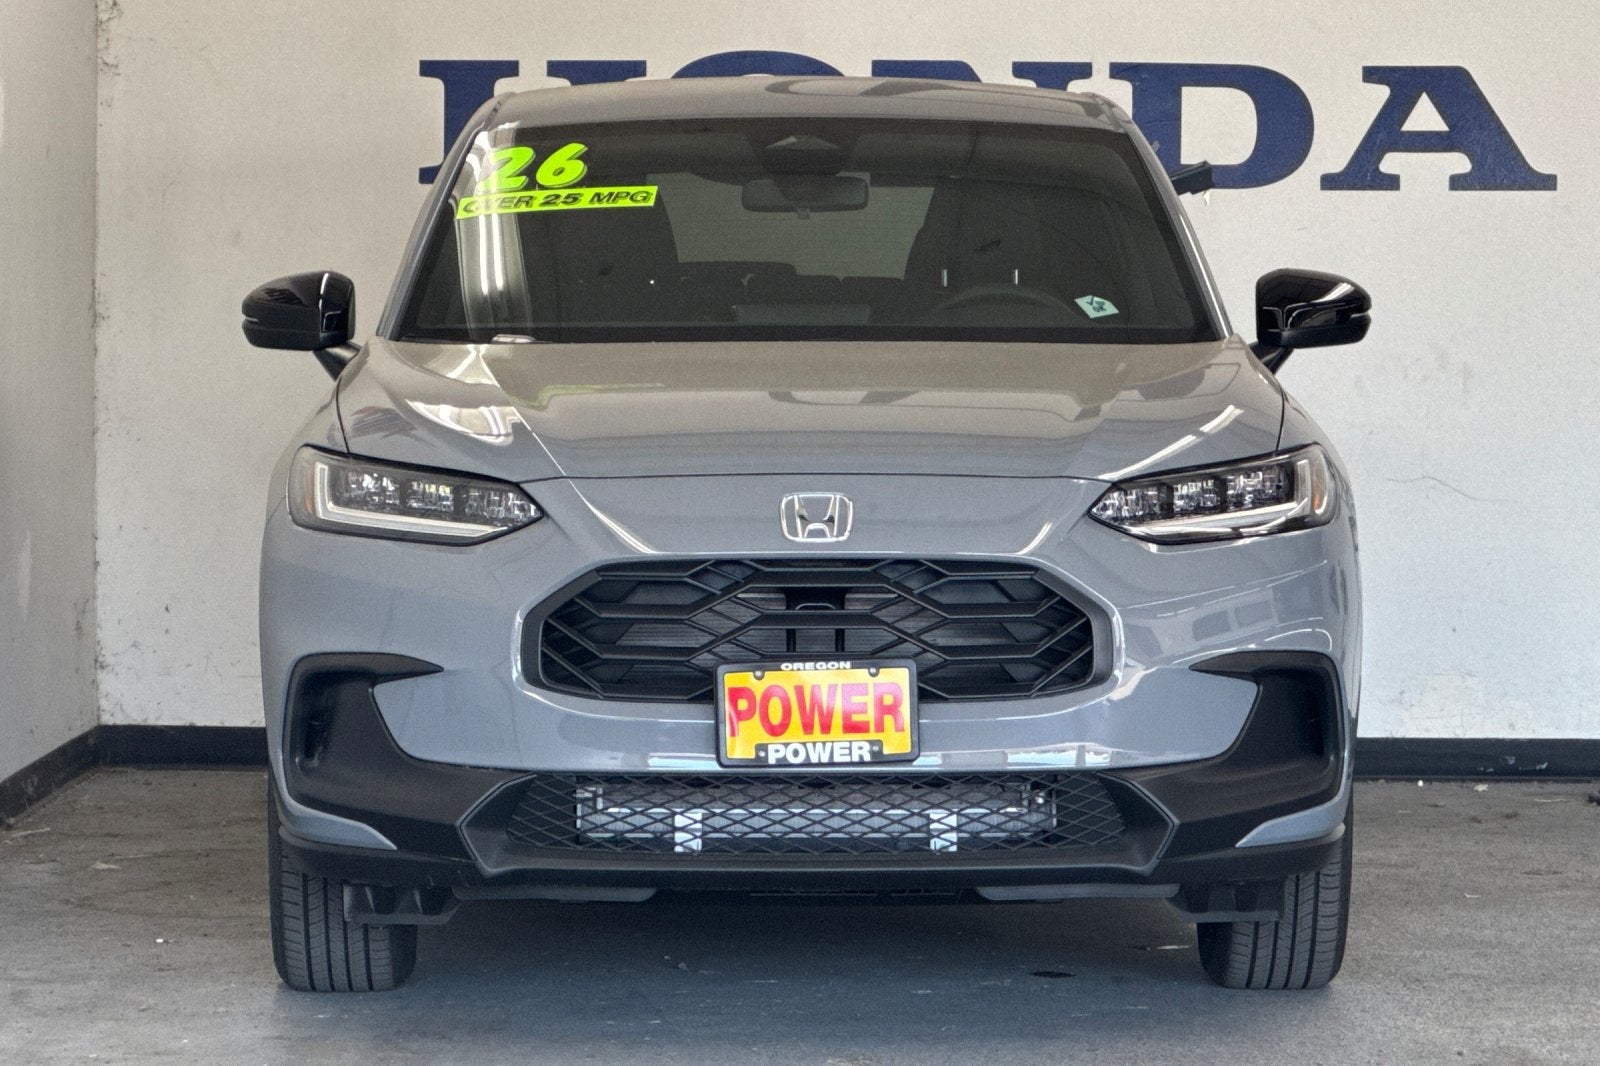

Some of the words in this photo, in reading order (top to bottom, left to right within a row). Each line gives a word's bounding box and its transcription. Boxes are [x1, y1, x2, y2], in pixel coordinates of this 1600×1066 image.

[419, 50, 1558, 191] HDA
[479, 142, 588, 192] 26
[539, 192, 584, 208] 25
[588, 190, 655, 205] MPG
[780, 660, 851, 672] OREGON
[727, 682, 905, 738] POWER
[767, 740, 871, 765] POWER
